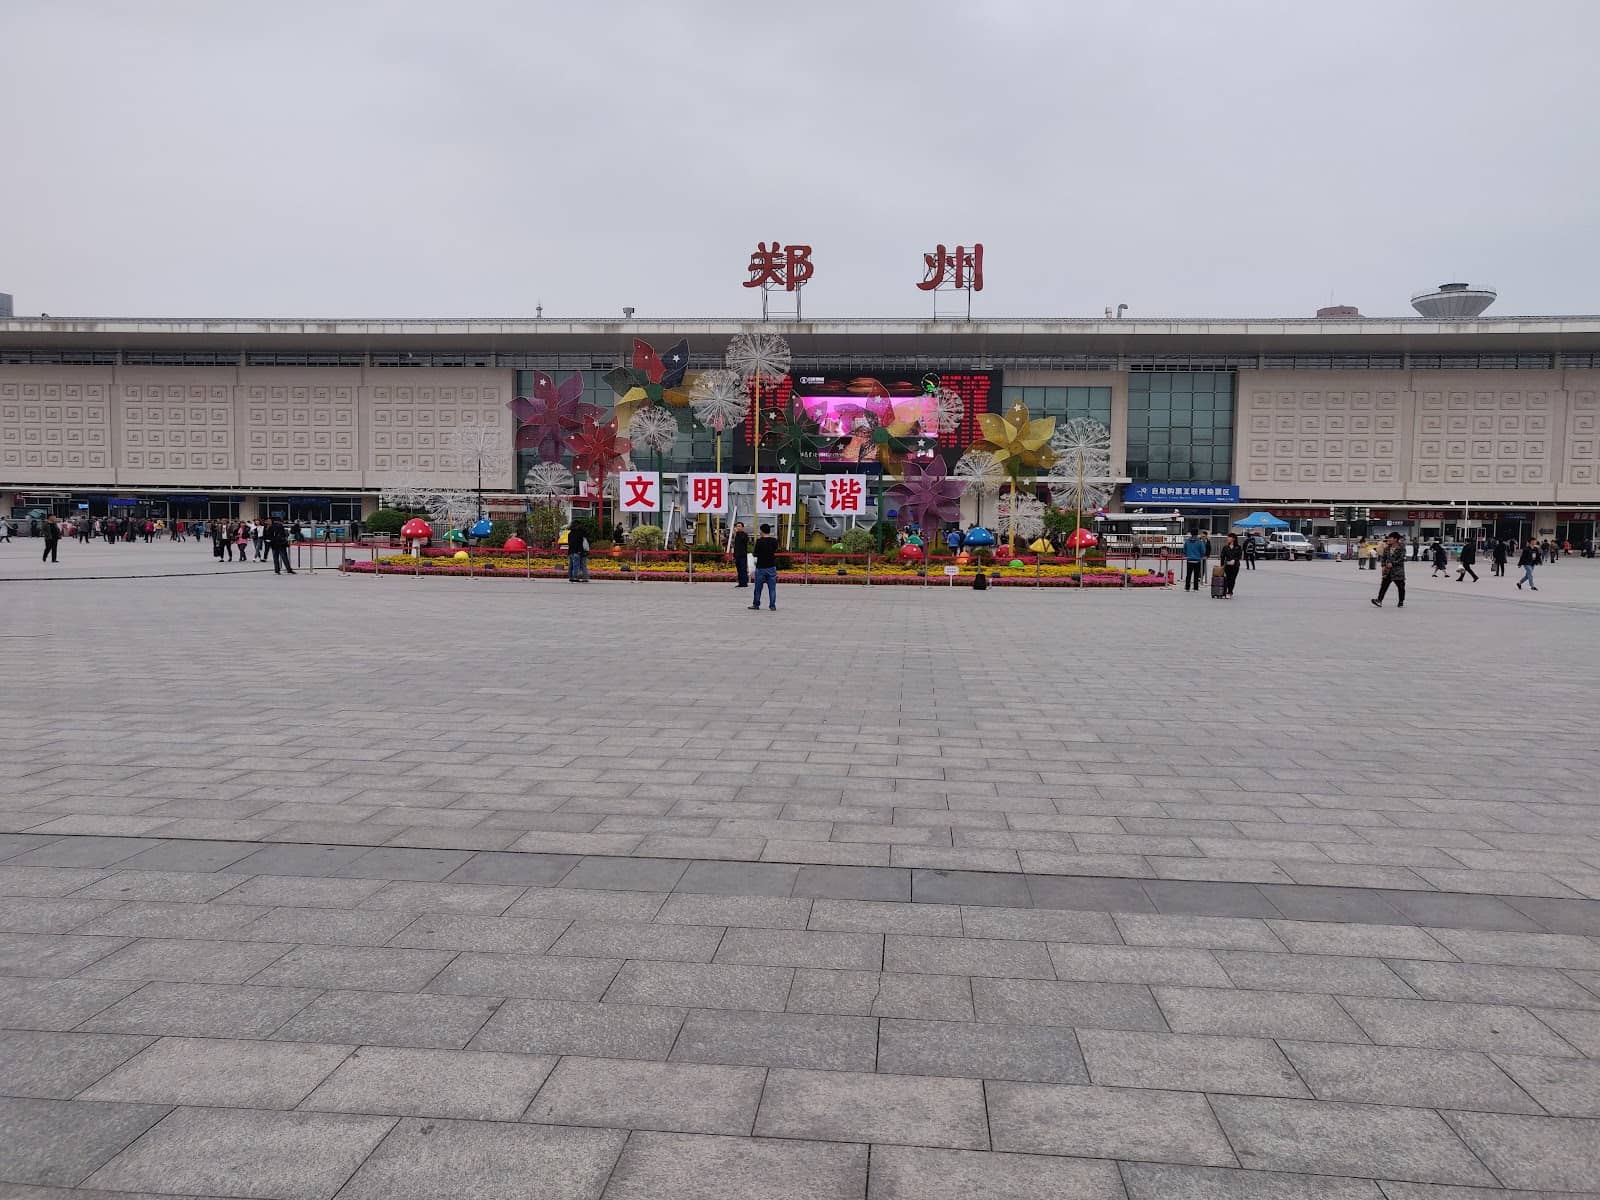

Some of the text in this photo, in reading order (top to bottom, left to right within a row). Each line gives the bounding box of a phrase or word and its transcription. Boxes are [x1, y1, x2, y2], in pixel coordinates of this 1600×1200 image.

[743, 241, 984, 291] 郑州
[625, 475, 862, 511] 文明和谐
